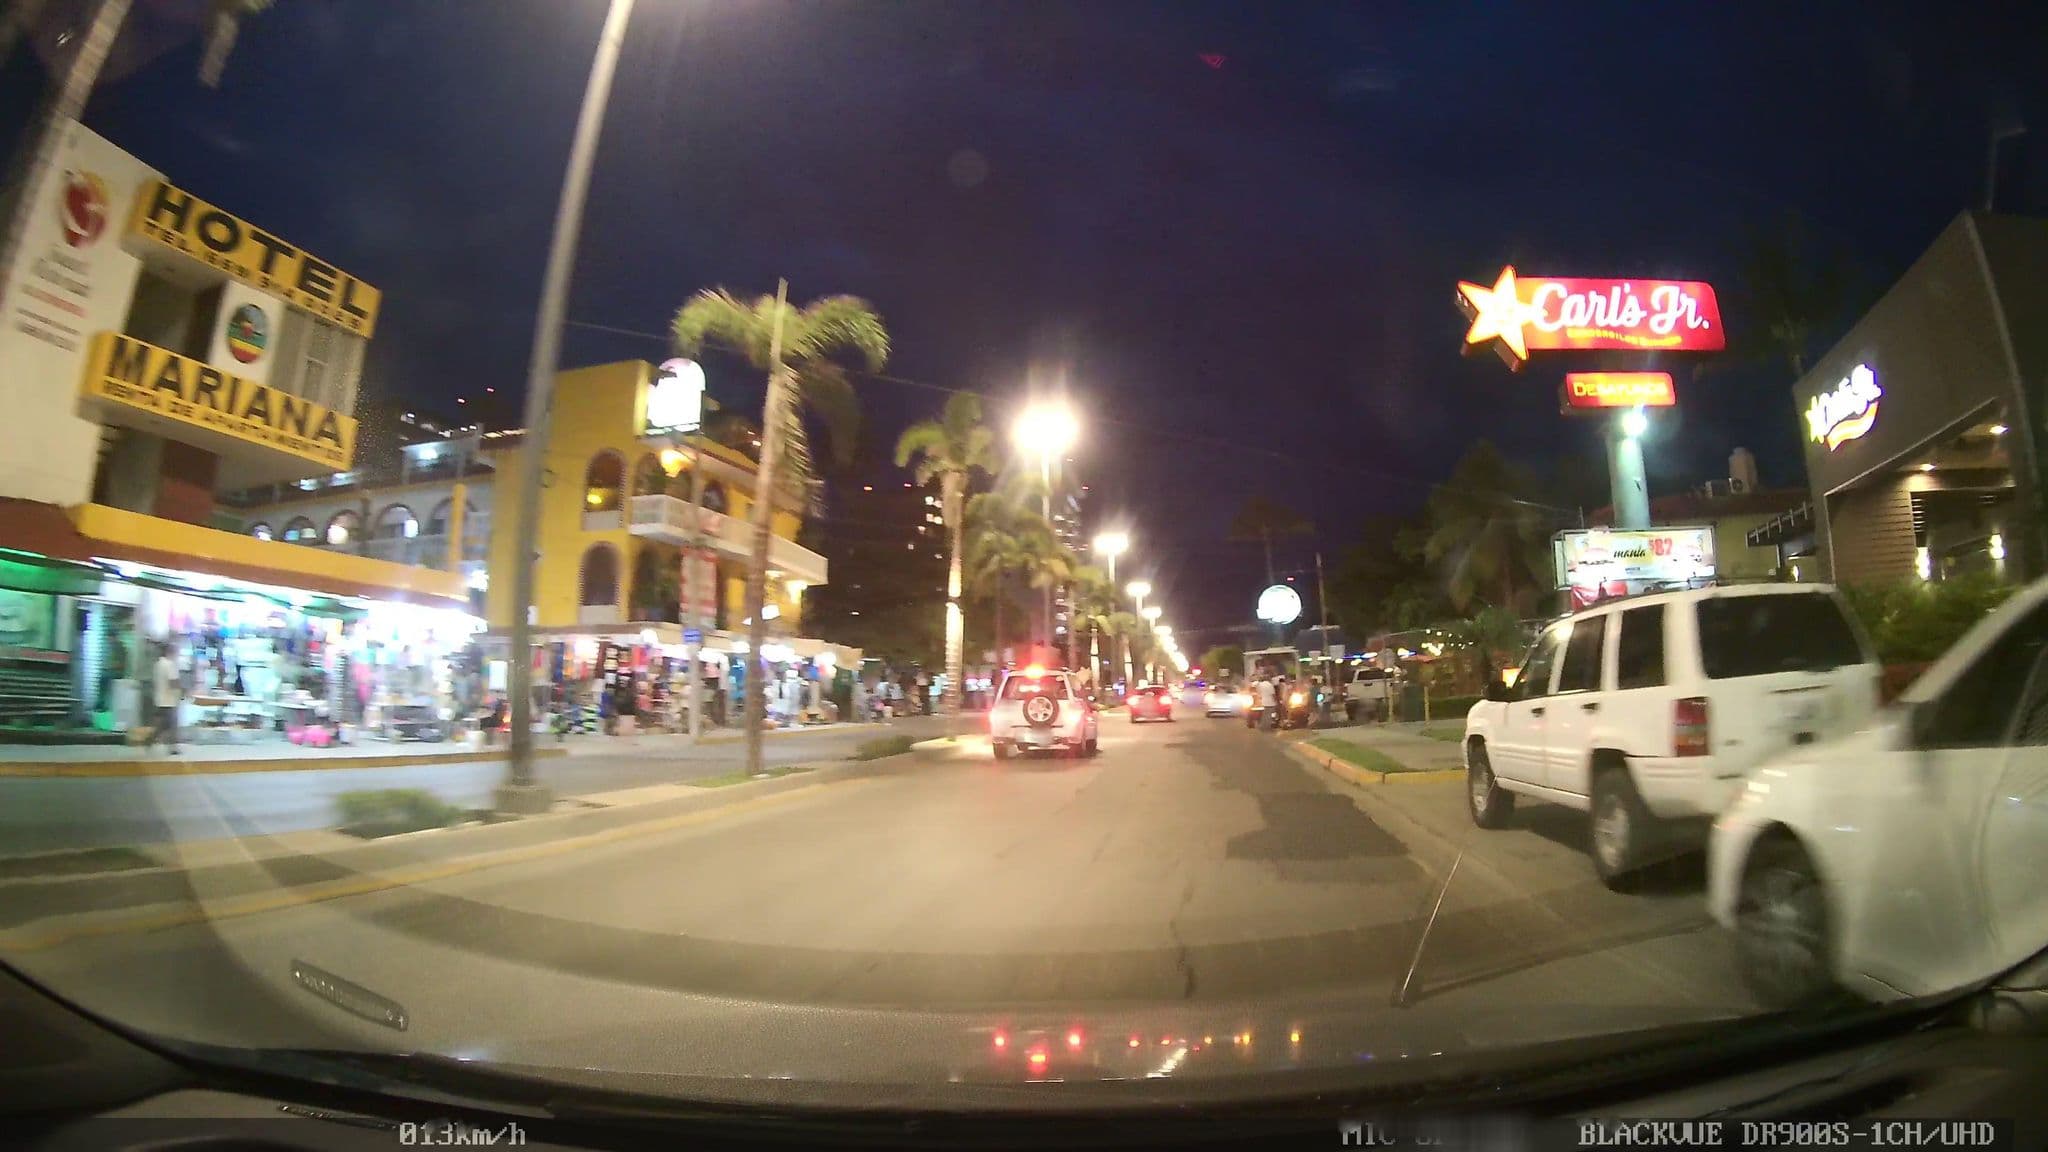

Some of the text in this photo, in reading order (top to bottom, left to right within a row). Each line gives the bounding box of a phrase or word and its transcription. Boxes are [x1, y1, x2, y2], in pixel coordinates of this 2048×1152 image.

[145, 182, 369, 320] HOTEL
[1531, 282, 1710, 335] Carl's Jr.
[105, 335, 345, 448] MARIANA
[1613, 545, 1646, 558] mania
